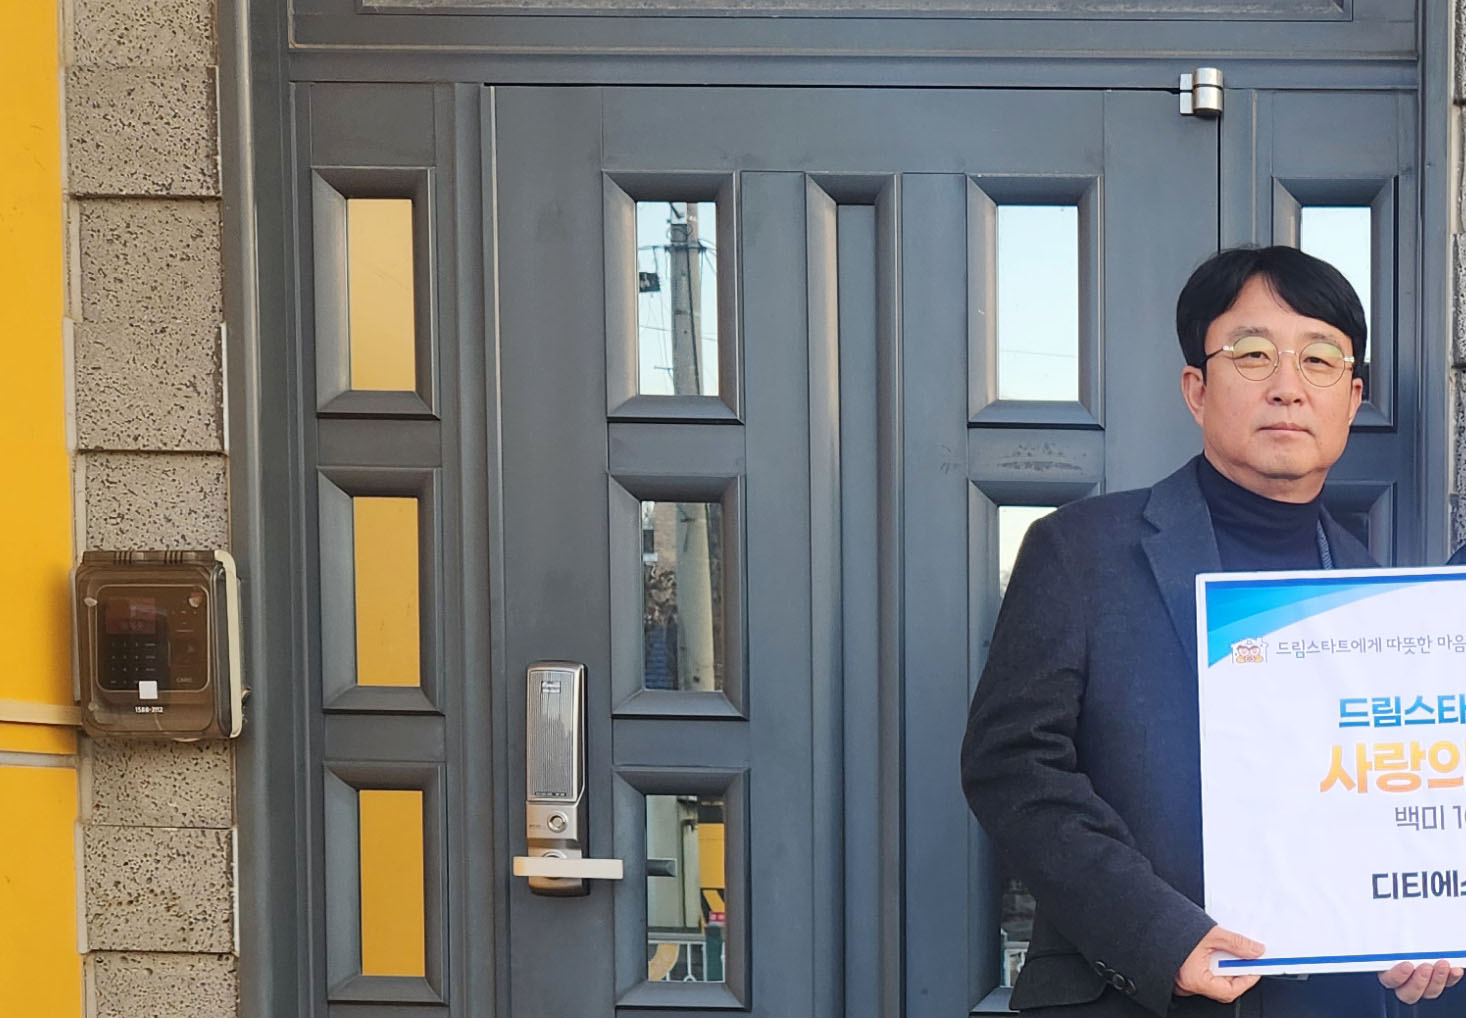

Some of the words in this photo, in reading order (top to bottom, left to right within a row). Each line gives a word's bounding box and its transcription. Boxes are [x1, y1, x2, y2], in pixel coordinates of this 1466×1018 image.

[1275, 638, 1382, 659] 드림스타트에게
[1386, 635, 1432, 655] 따뜻한
[1394, 804, 1445, 831] 백미
